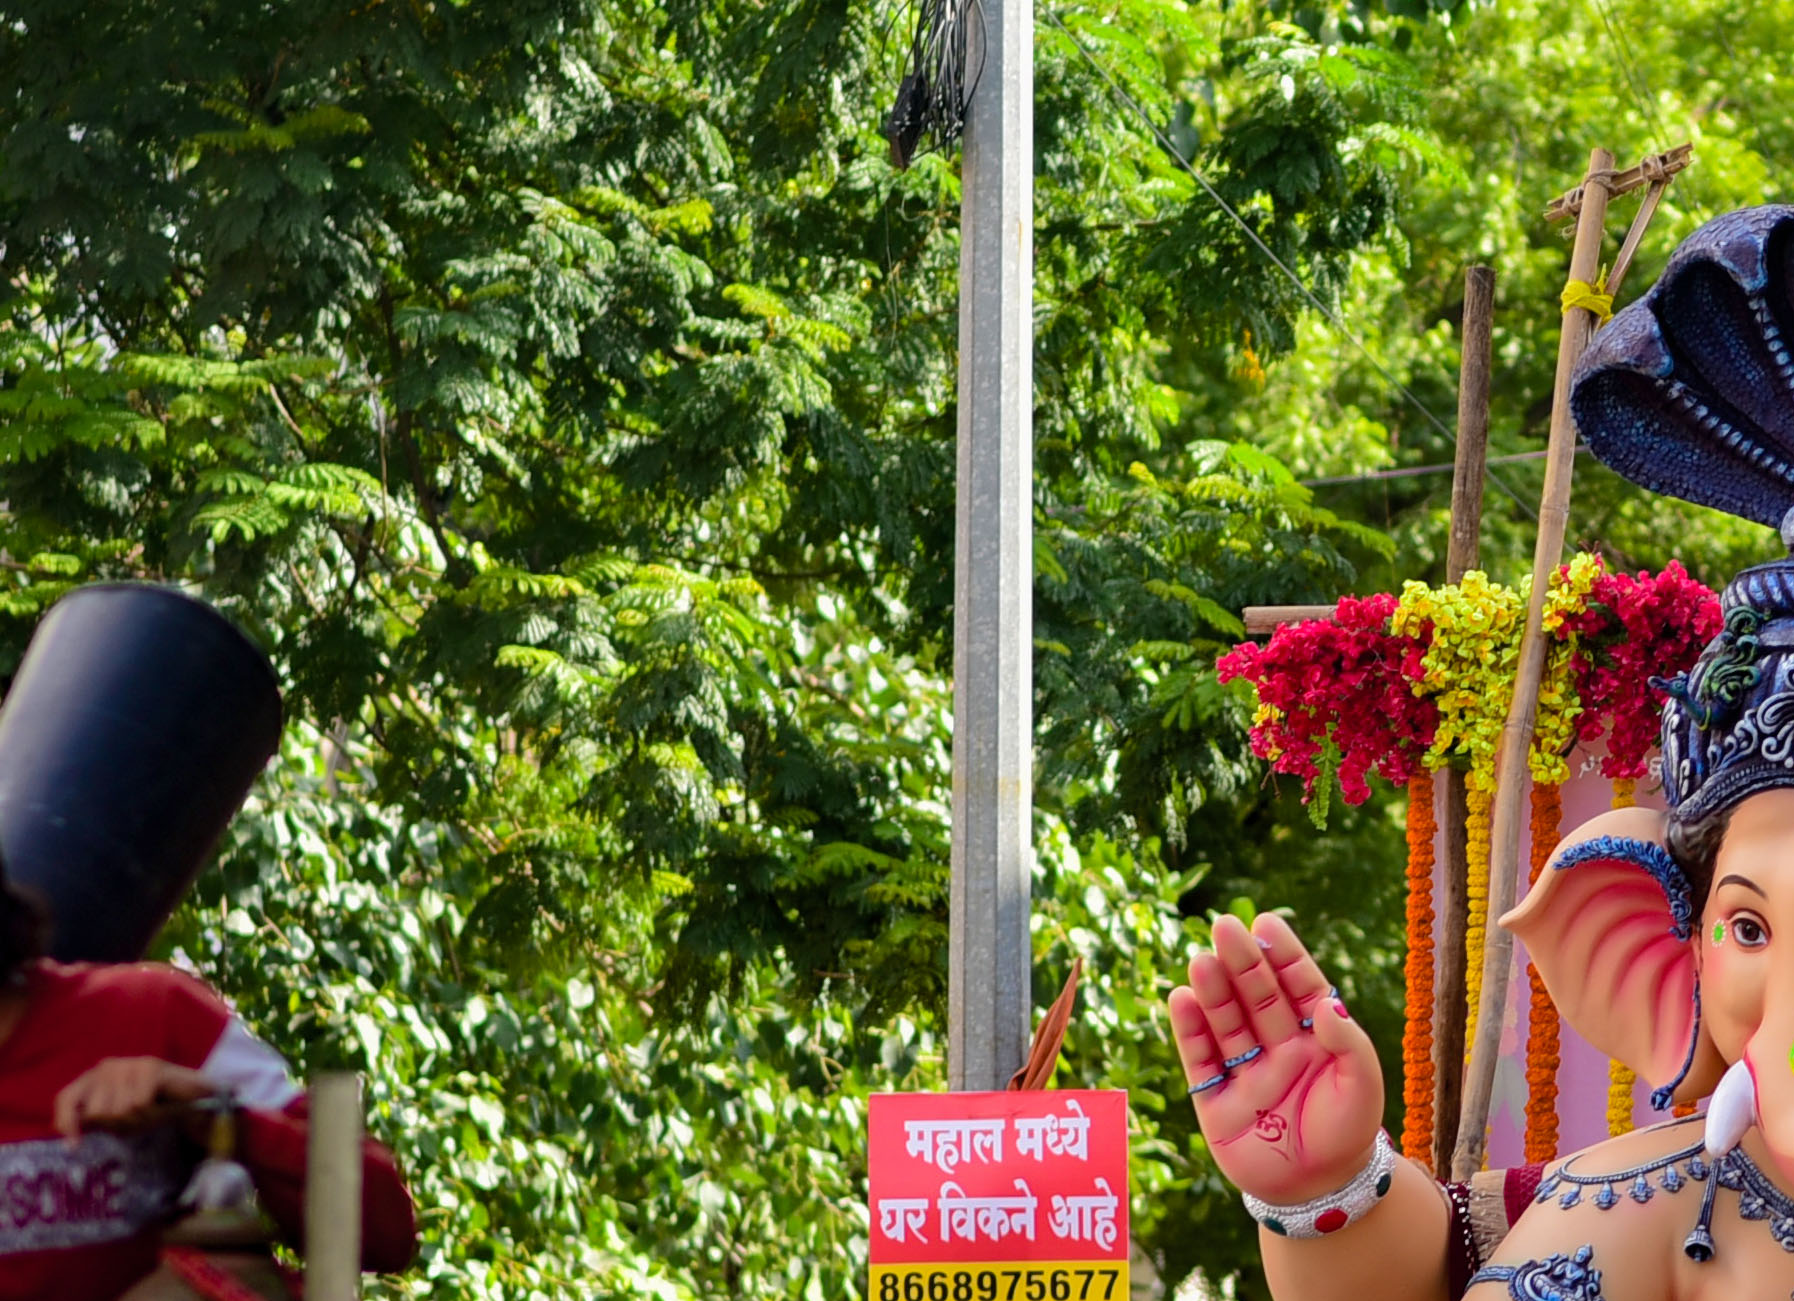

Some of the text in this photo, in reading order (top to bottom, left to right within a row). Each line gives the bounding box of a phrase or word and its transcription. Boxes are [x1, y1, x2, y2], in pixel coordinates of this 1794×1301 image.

[904, 1098, 1091, 1174] महाल मध्ये
[0, 1157, 129, 1228] SOME
[878, 1177, 1118, 1251] घर विकने आहे
